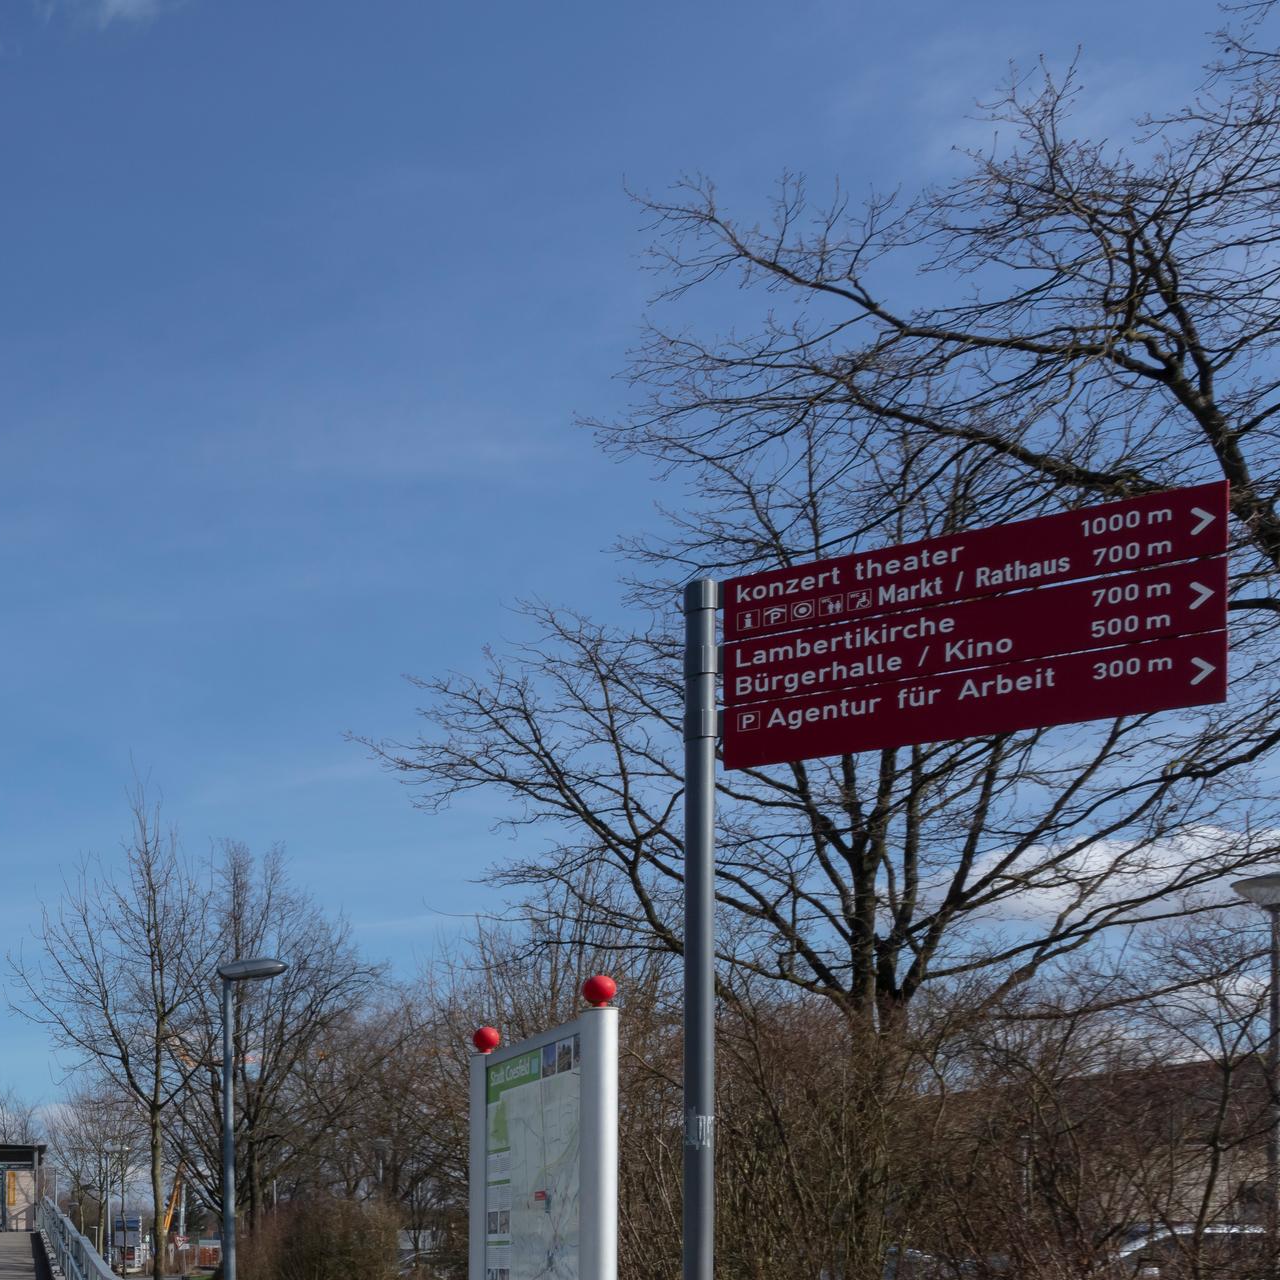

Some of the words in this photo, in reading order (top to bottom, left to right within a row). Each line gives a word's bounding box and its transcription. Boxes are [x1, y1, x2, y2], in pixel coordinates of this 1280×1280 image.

[737, 568, 840, 604] konzert
[856, 546, 965, 581] theater
[1081, 511, 1140, 537] 1000
[1148, 509, 1172, 525] m
[878, 577, 943, 607] Markt
[955, 570, 964, 592] /
[976, 556, 1071, 588] Rathaus
[1092, 543, 1140, 567] 700
[1148, 541, 1172, 556] m
[736, 617, 955, 668] Lambertikirche
[1092, 584, 1139, 607] 700
[1147, 583, 1171, 598] m
[736, 654, 903, 696] Bürgerhalle
[918, 646, 929, 667] /
[945, 638, 1013, 663] Kino
[1092, 616, 1139, 638] 500
[1147, 614, 1171, 630] m
[767, 698, 882, 730] Agentur
[898, 688, 941, 709] für
[958, 668, 1056, 701] Arbeit
[1093, 658, 1140, 680] 300
[1148, 657, 1173, 673] m
